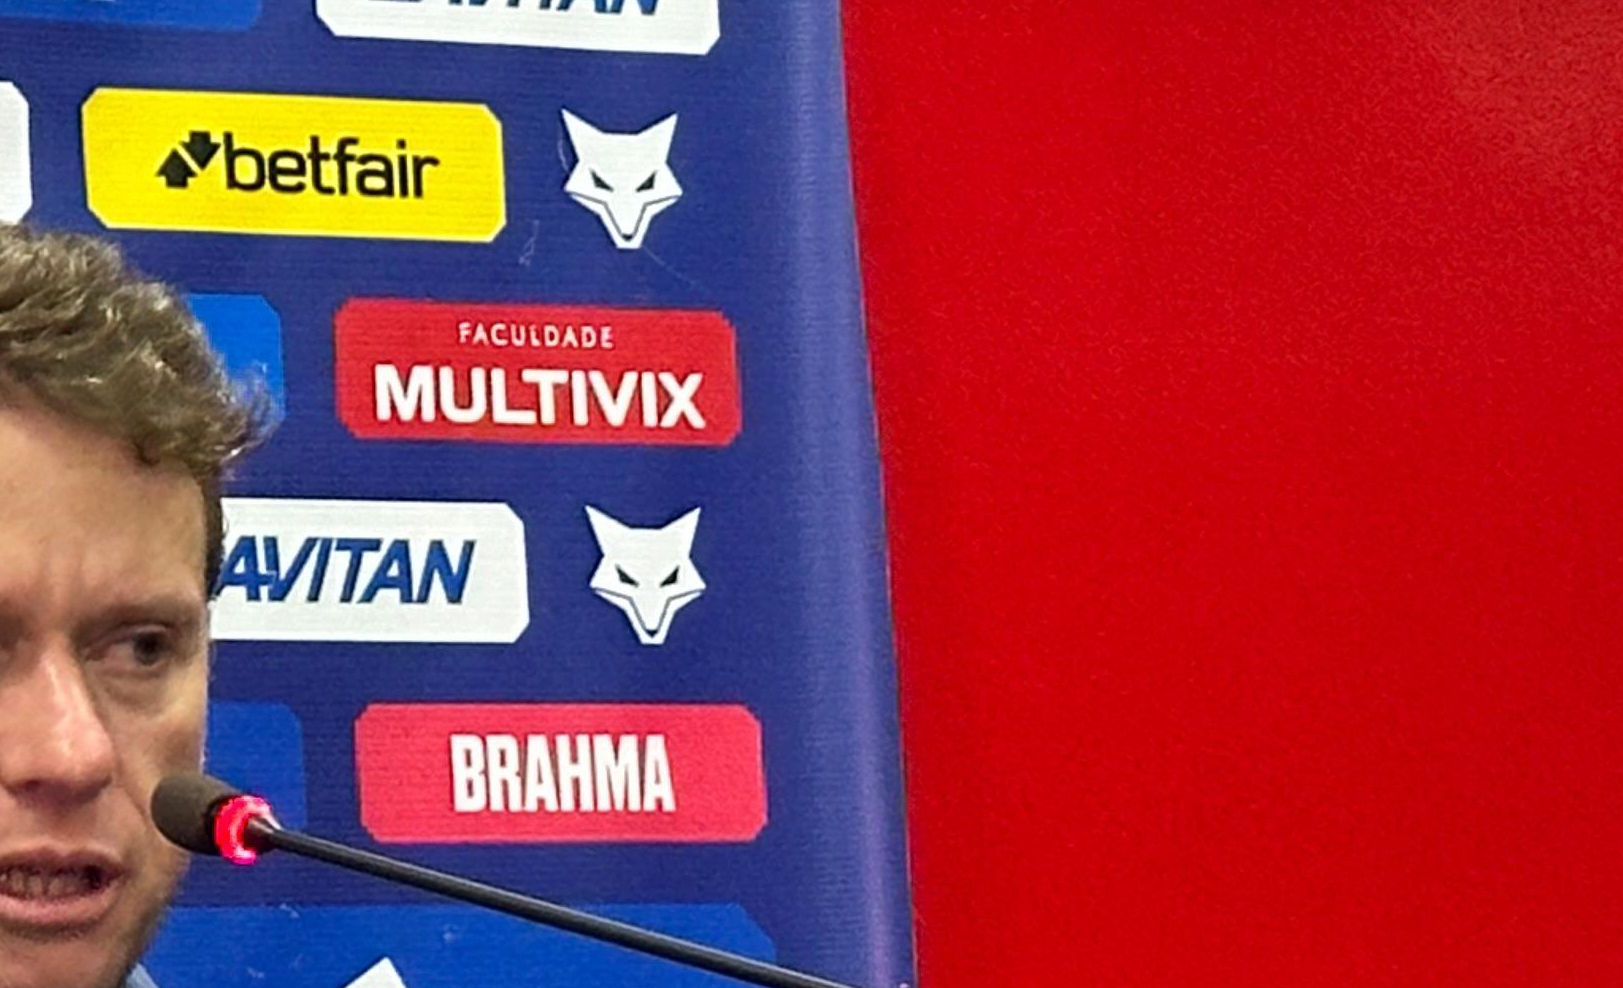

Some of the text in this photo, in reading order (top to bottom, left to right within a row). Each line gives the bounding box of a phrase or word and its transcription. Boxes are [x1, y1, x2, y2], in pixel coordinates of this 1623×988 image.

[223, 131, 440, 198] betfair
[458, 322, 614, 348] FACULDADE
[374, 363, 706, 429] MULTIVIX
[450, 733, 675, 813] BRAHMA
